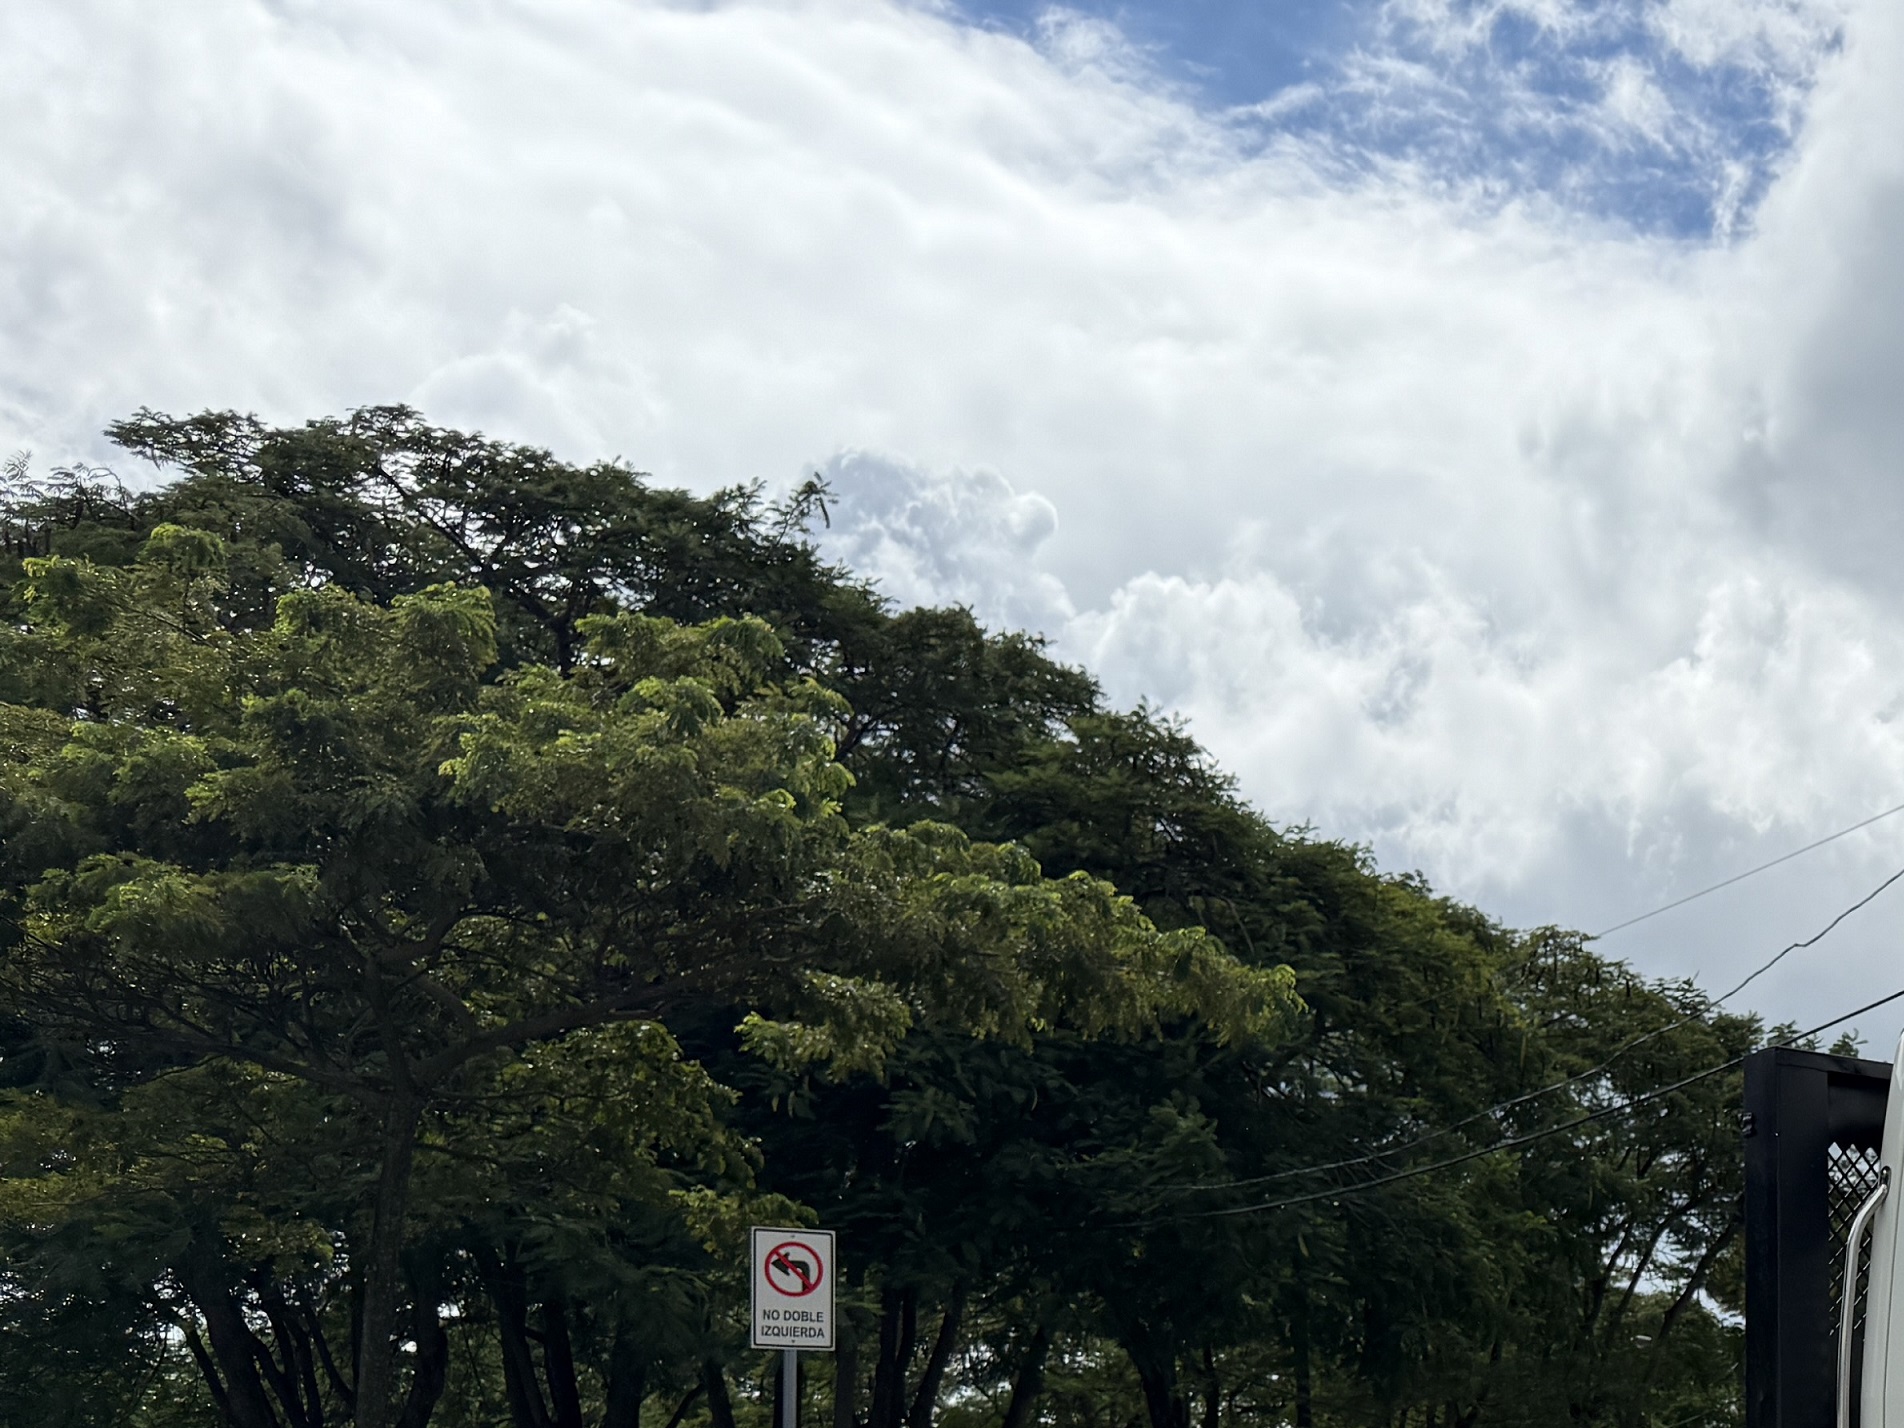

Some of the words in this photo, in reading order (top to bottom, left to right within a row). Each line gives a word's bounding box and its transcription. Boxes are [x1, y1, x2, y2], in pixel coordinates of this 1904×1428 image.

[763, 1309, 780, 1321] NO
[783, 1310, 824, 1323] DOBLE
[761, 1325, 825, 1338] IZQUIERDA
